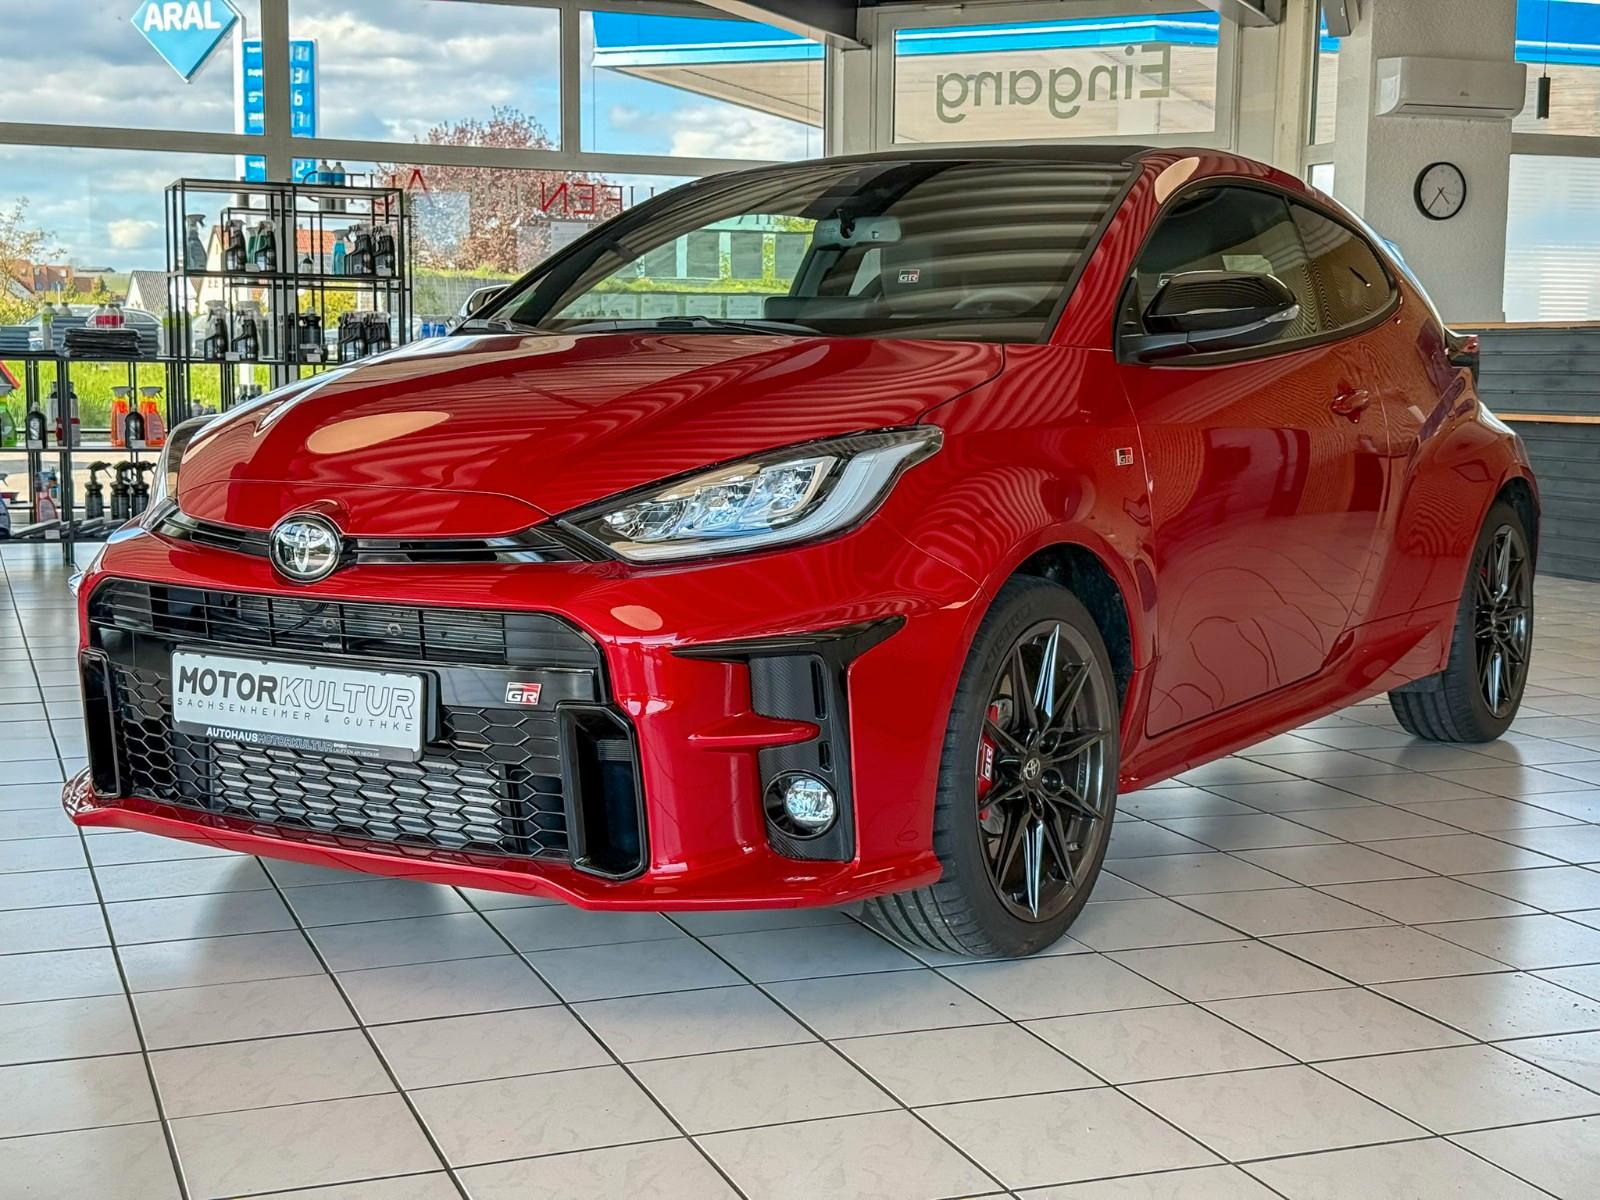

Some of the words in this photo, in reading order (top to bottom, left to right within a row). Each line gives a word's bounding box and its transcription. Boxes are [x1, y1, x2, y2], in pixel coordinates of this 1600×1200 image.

[144, 1, 221, 32] ARAL
[899, 273, 919, 282] GR
[178, 665, 415, 719] MOTORKULTUR
[507, 690, 538, 703] GR
[177, 697, 311, 721] SACHSENHEIMER
[324, 714, 330, 723] &
[343, 716, 413, 731] GUTHKE
